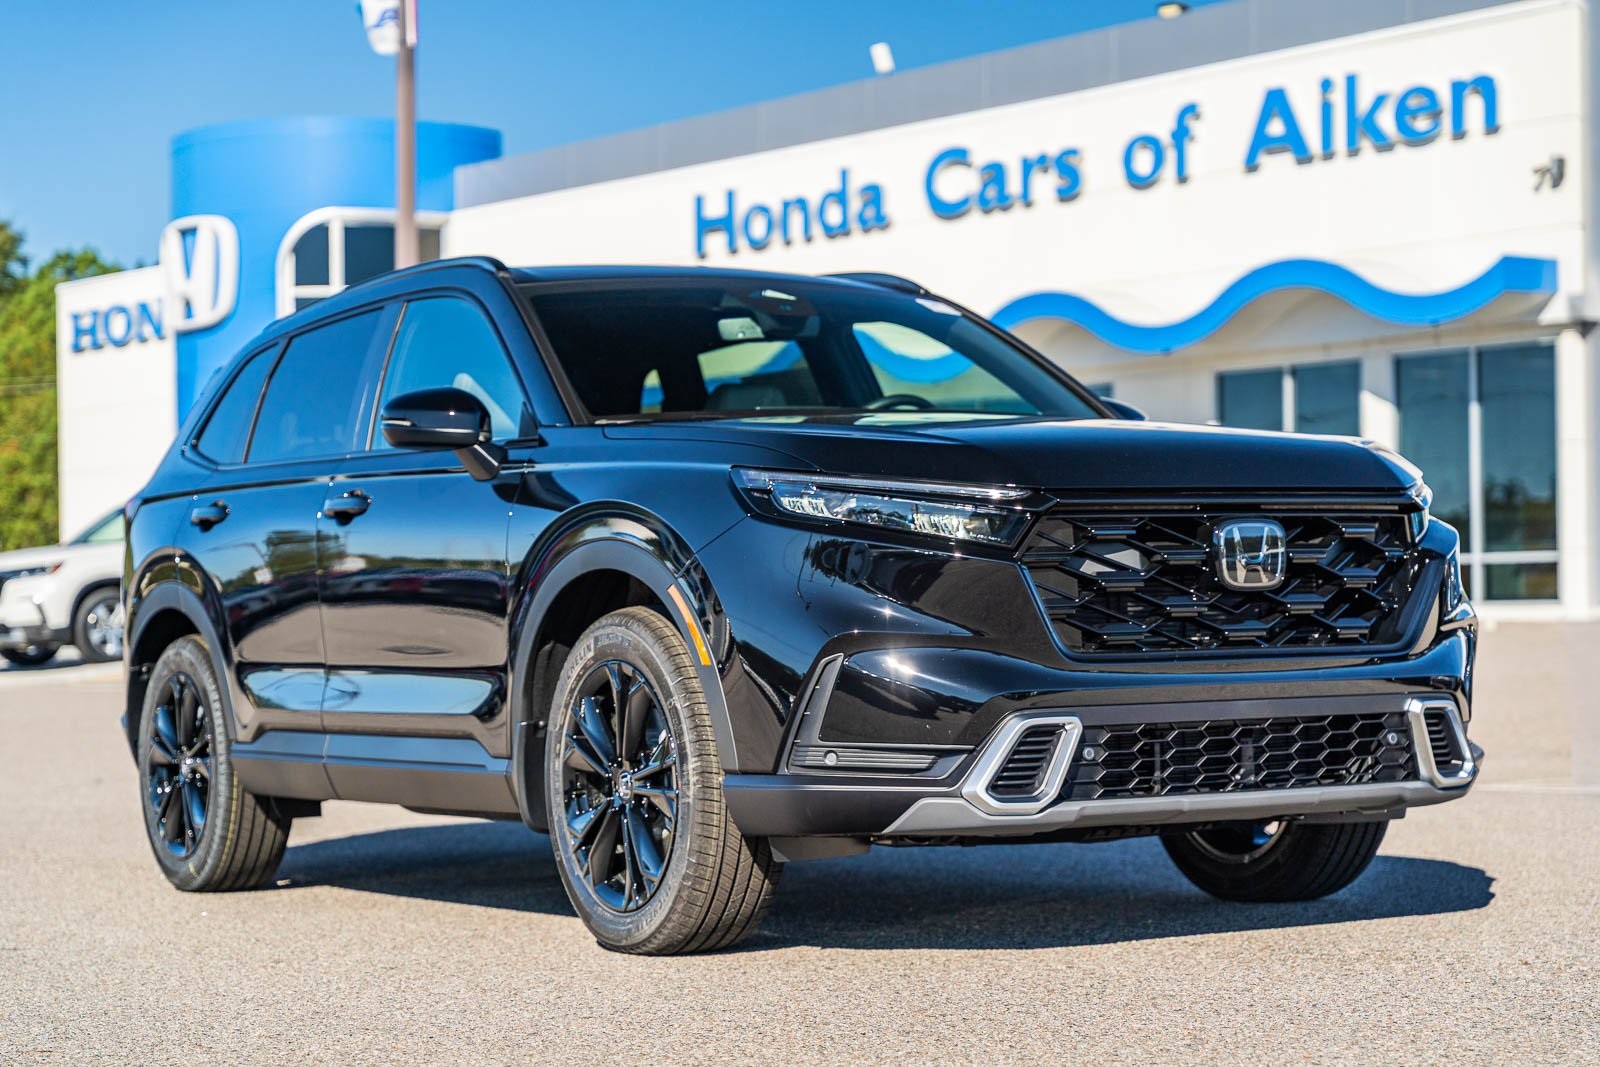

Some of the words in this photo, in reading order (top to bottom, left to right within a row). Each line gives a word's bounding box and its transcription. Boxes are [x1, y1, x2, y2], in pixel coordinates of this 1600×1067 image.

[695, 168, 892, 260] Honda
[925, 146, 1083, 221] Cars
[1122, 102, 1202, 191] of
[1243, 73, 1501, 174] Aiken
